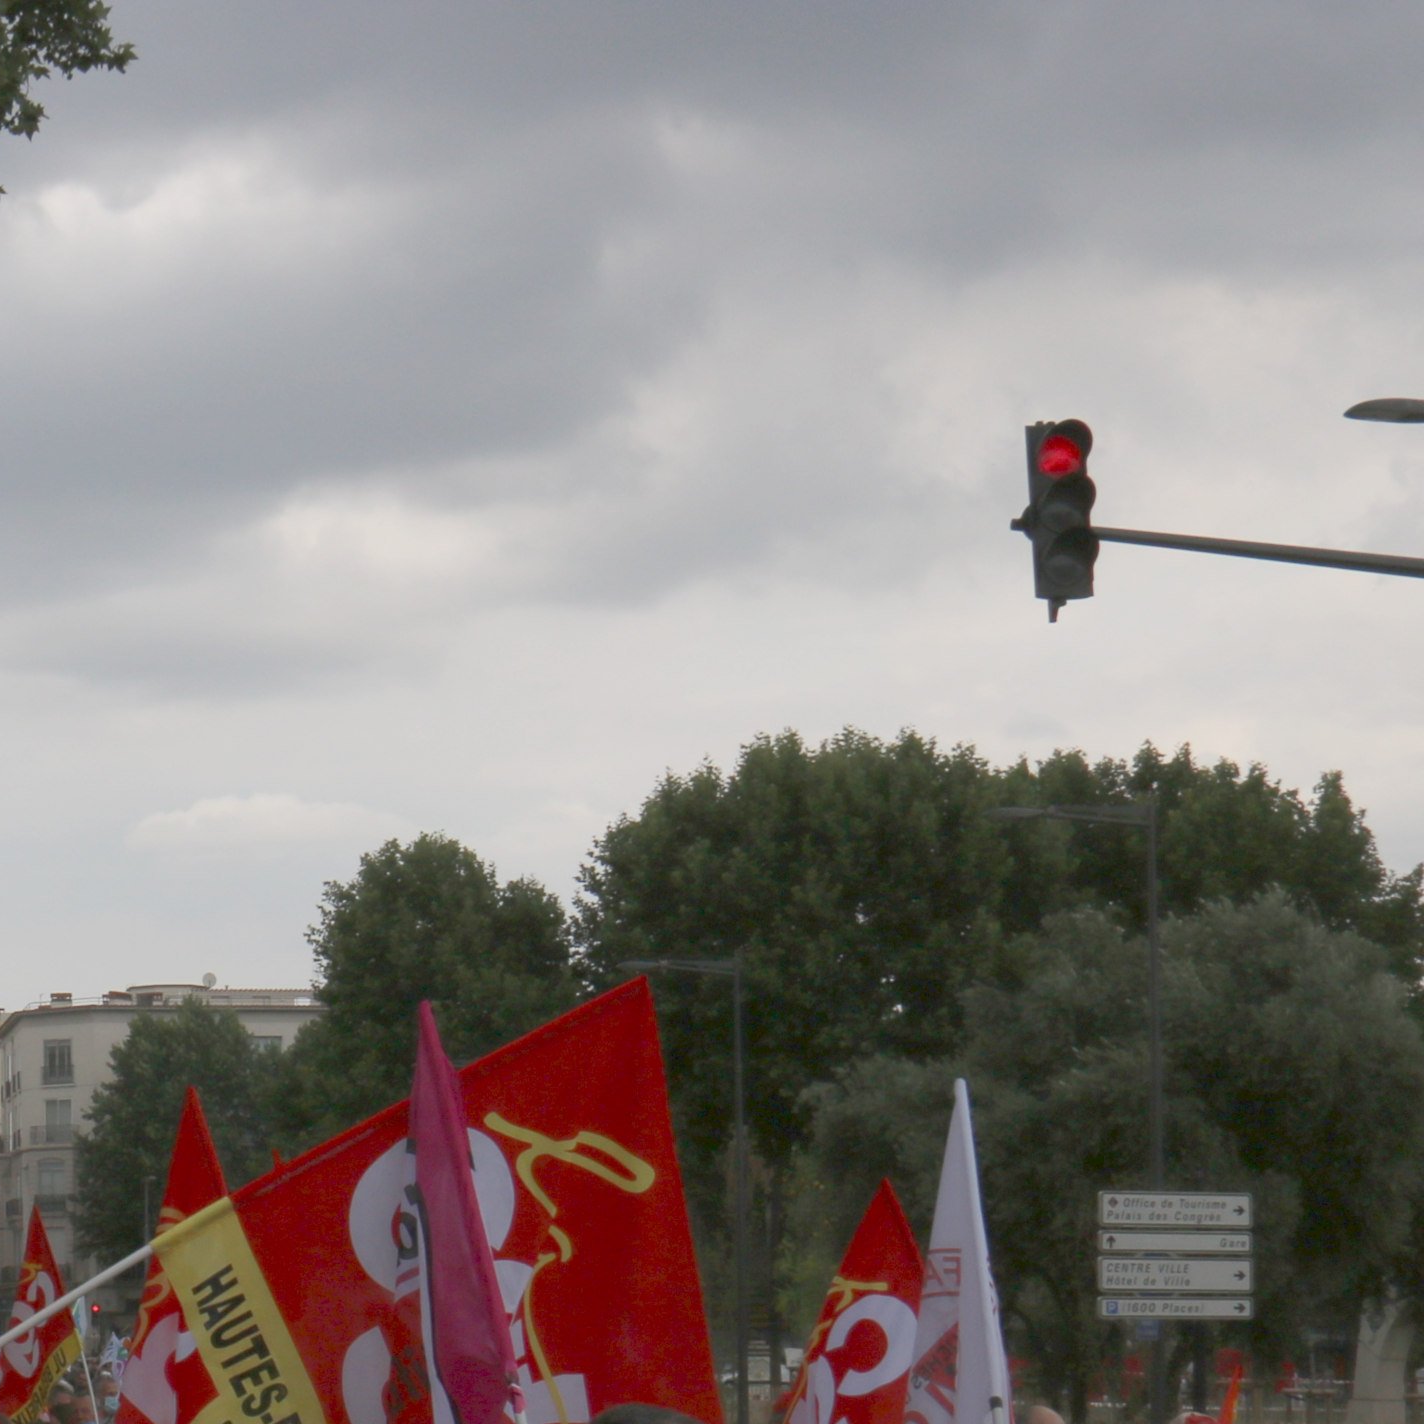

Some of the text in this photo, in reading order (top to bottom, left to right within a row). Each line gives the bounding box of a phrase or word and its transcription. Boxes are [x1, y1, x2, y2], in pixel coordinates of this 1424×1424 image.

[1123, 1197, 1227, 1209] Office de Tourisme
[1106, 1210, 1221, 1224] Palais des Congrès
[1219, 1238, 1247, 1248] Gare
[1106, 1263, 1191, 1274] CENTRE VILLE
[1106, 1276, 1191, 1286] Hôtel de Ville
